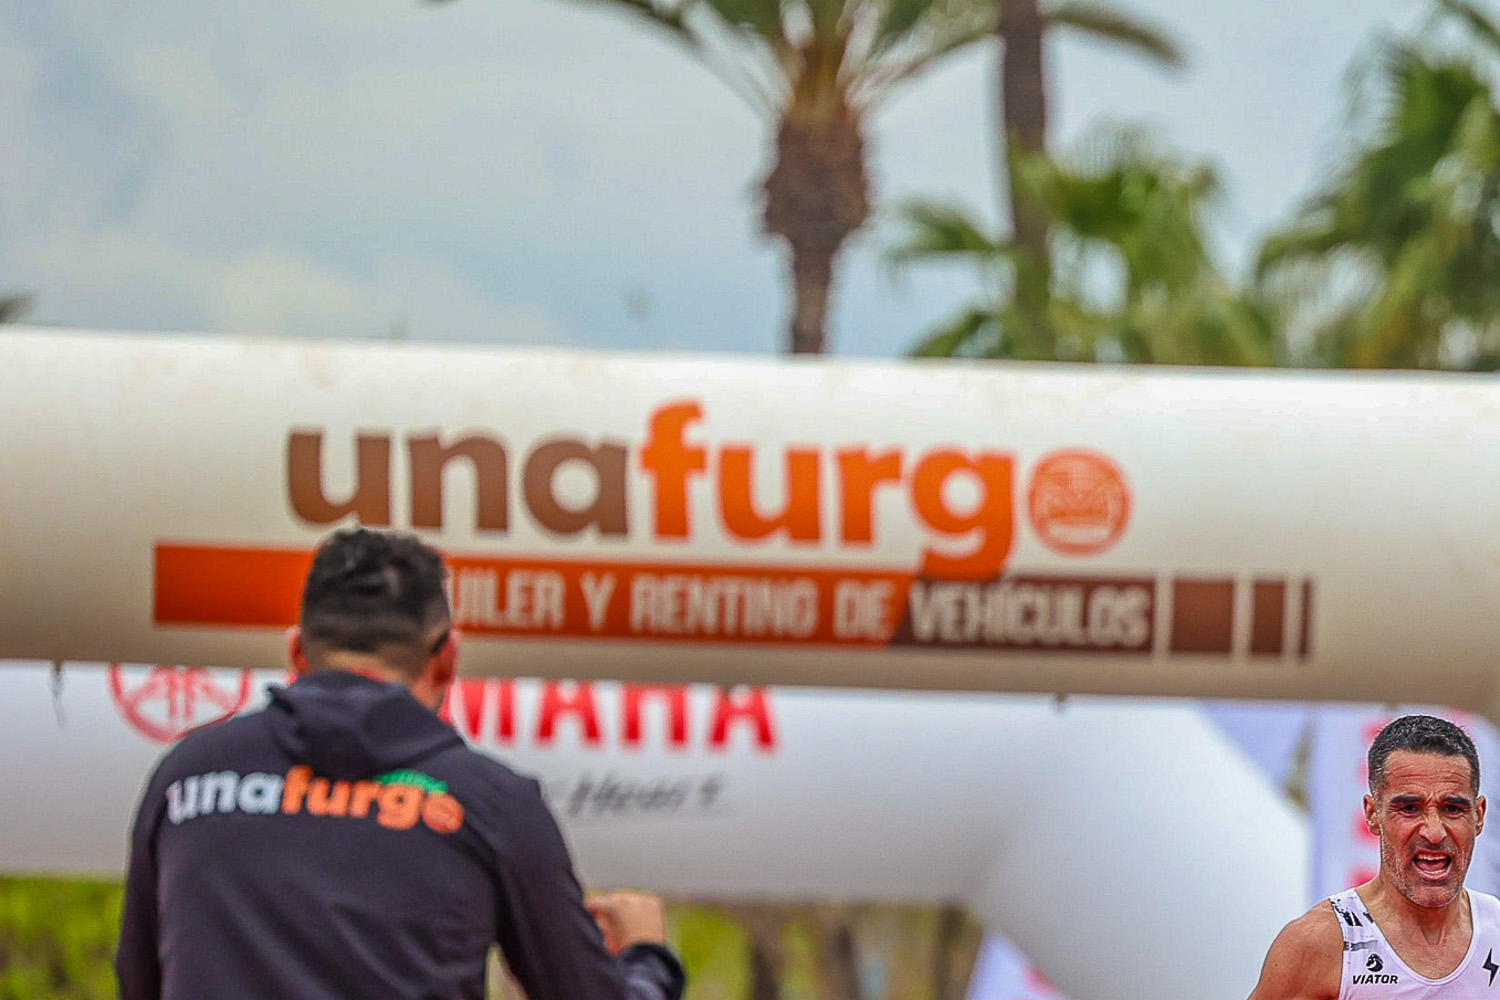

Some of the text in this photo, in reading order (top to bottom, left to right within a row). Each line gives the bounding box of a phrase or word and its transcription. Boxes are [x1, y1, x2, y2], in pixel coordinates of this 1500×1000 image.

[446, 567, 565, 630] UILER
[580, 571, 616, 631] Y
[630, 574, 820, 638] RENTING
[833, 580, 896, 641] DE
[438, 677, 777, 750] MAHA
[166, 765, 465, 834] unafurgo
[1352, 974, 1399, 985] VIATOR
